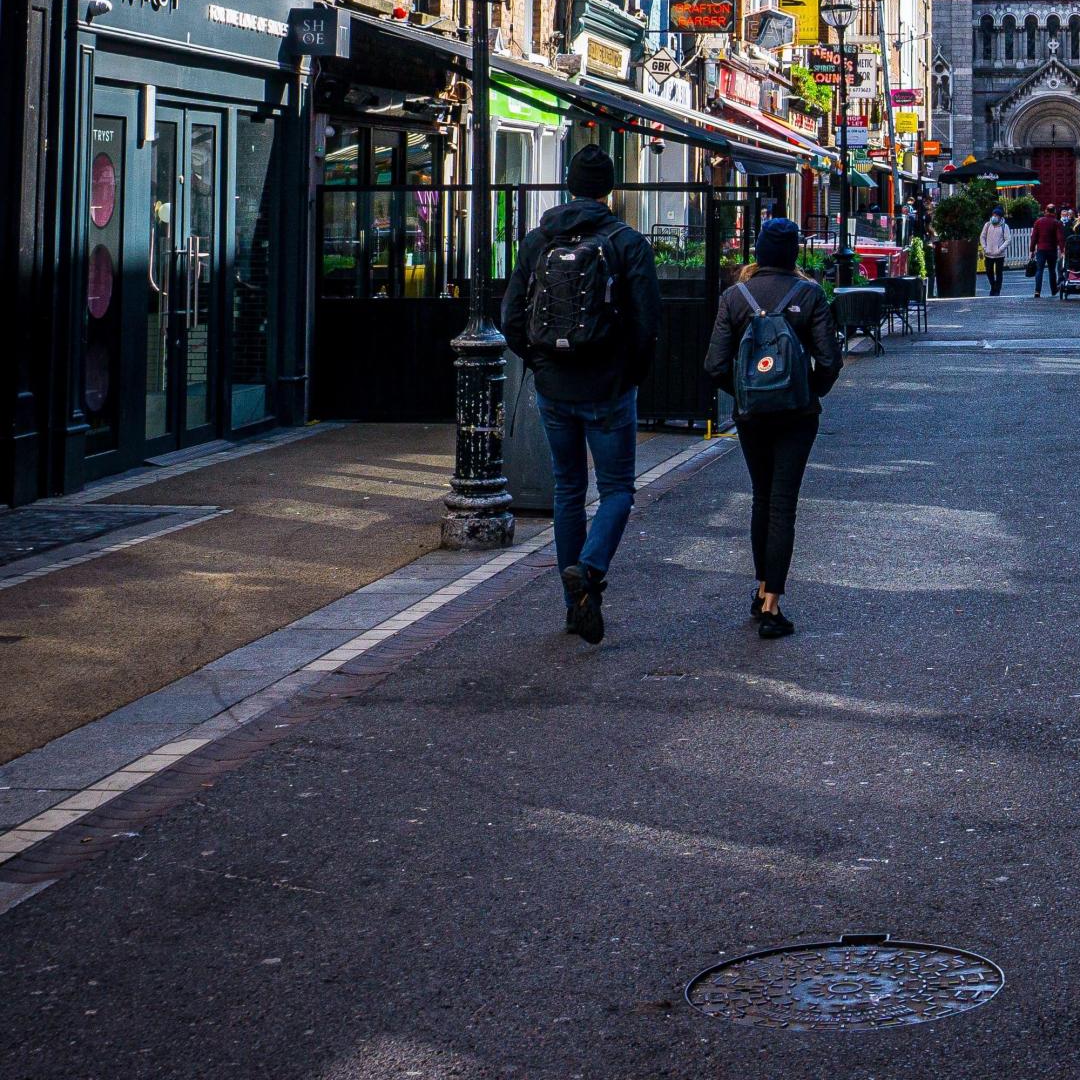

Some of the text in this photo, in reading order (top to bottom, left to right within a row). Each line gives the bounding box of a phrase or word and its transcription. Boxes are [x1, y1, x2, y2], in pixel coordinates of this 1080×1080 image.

[675, 3, 731, 14] GRAFTON
[678, 16, 727, 26] BARBER
[652, 61, 671, 72] GBK
[92, 129, 115, 143] TRYST
